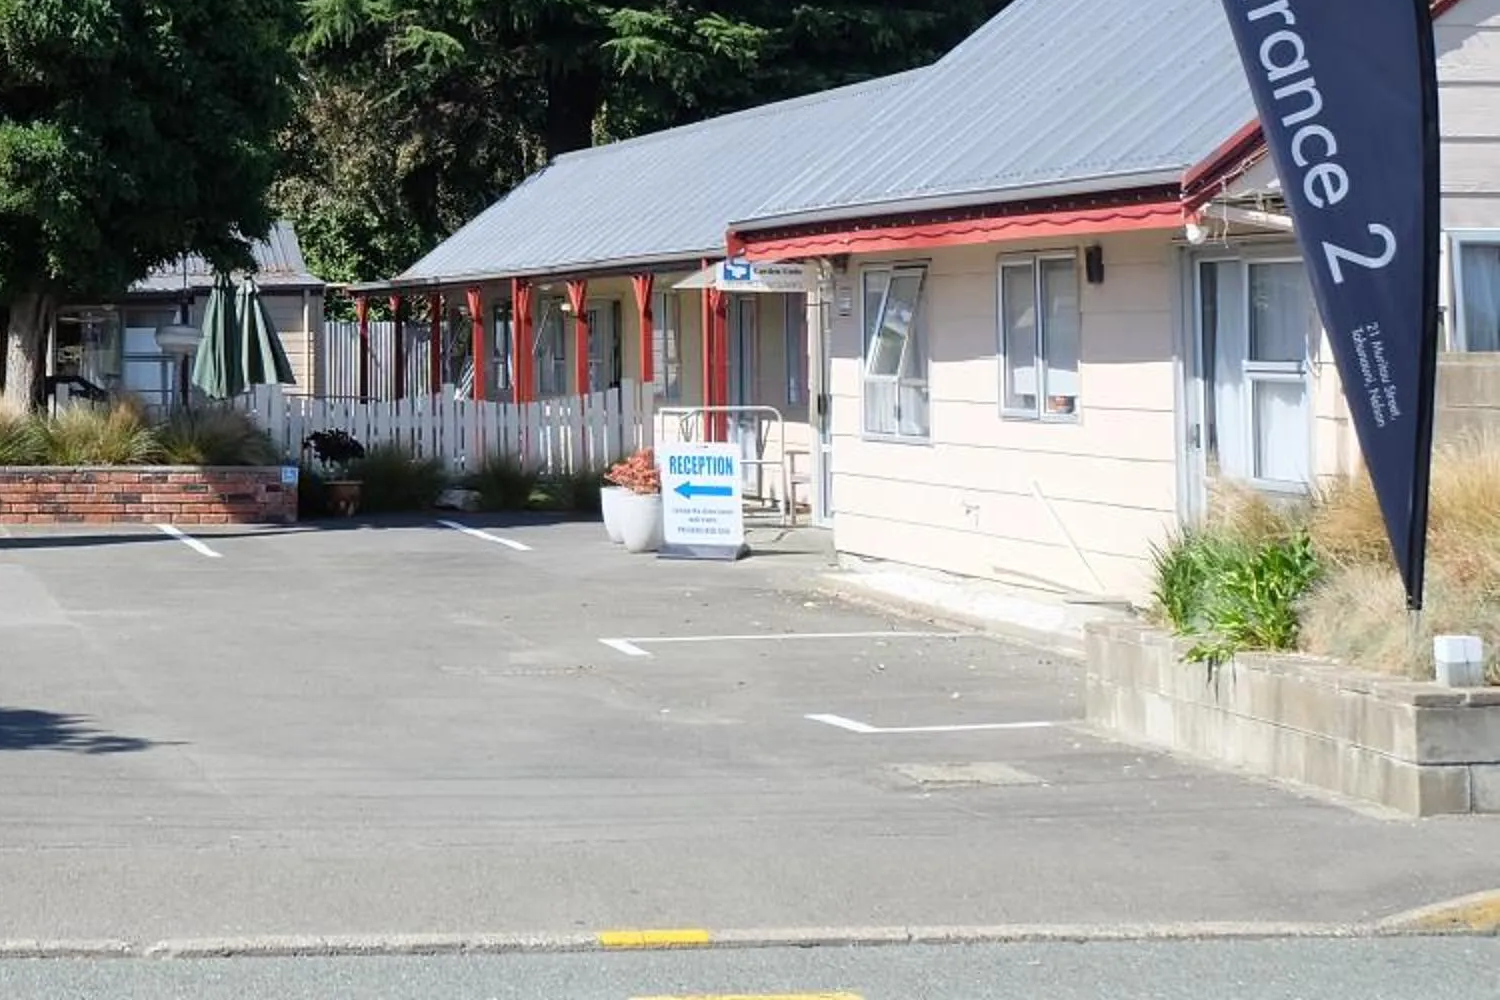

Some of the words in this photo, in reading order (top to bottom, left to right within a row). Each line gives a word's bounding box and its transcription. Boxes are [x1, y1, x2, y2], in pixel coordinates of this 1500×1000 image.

[1322, 223, 1397, 285] 2
[1366, 321, 1380, 337] 21
[669, 456, 734, 475] RECEPTION
